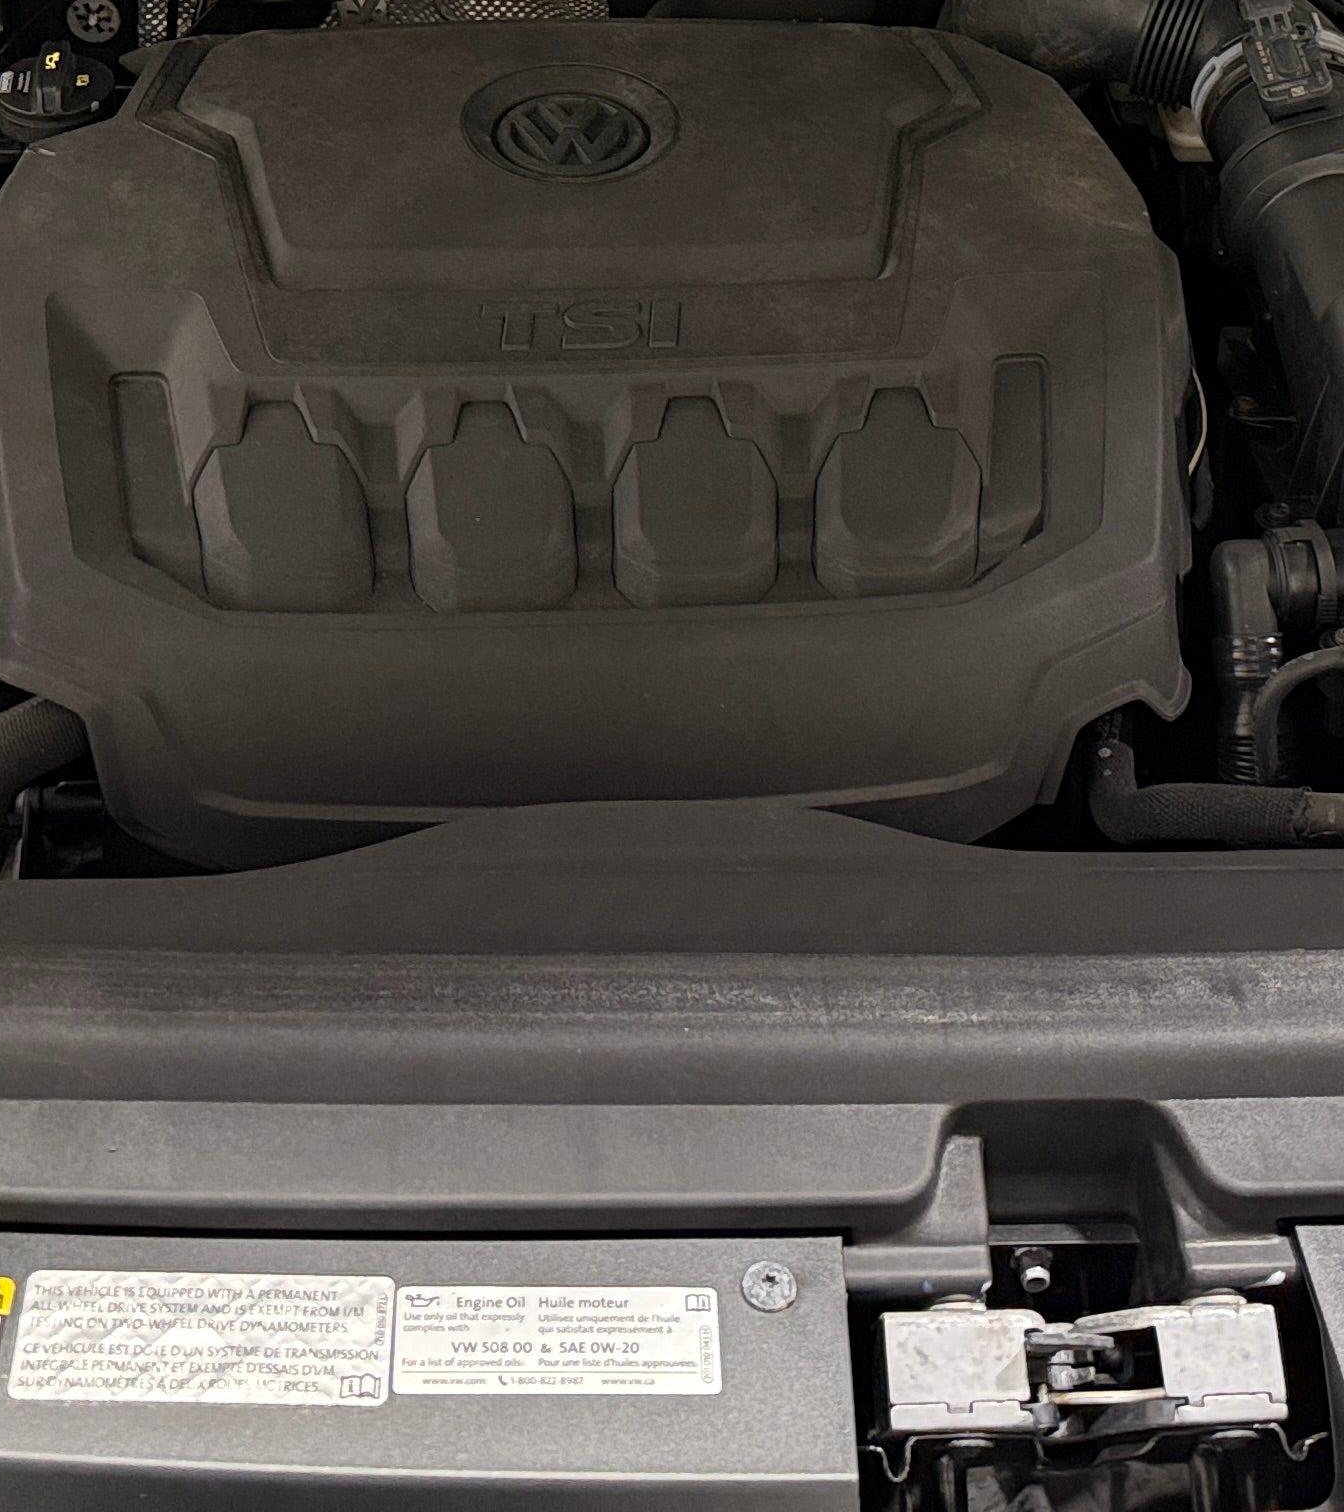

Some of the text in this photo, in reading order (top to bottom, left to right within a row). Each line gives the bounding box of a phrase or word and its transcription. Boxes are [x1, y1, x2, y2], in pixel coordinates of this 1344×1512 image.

[480, 298, 682, 352] TSI
[35, 1284, 339, 1301] THIS VEHICLE IS EQUIPPED WITH A PERMANENT
[30, 1300, 105, 1313] ALL-WHEEL
[107, 1301, 146, 1313] DRIVE
[150, 1302, 198, 1314] SYSTEM
[201, 1303, 232, 1315] AND
[235, 1304, 247, 1315] IS
[249, 1304, 301, 1317] EXEMPT
[304, 1305, 341, 1317] FROM
[456, 1295, 630, 1311] Engine Oil Huile moteur
[86, 1317, 107, 1329] ON
[111, 1317, 193, 1330] TWO-WHEEL
[196, 1318, 236, 1331] DRIVE
[404, 1312, 526, 1324] Use only oil that expressly
[538, 1313, 681, 1324] Utilisez uniquement de l'huile
[403, 1323, 470, 1334] complies with
[538, 1325, 554, 1335] qui
[556, 1324, 595, 1334] satisfait
[23, 1342, 39, 1354] CE
[108, 1343, 130, 1355] EST
[263, 1347, 281, 1359] DE
[285, 1348, 380, 1361] TRANSMISSION
[451, 1341, 641, 1354] VW 508 00 & SAE 0W-20
[91, 1359, 168, 1373] PERMANENT
[171, 1361, 185, 1373] ET
[401, 1357, 503, 1368] For a list of approved
[538, 1357, 639, 1367] Pour une liste d'huiles
[16, 1376, 44, 1387] SUR
